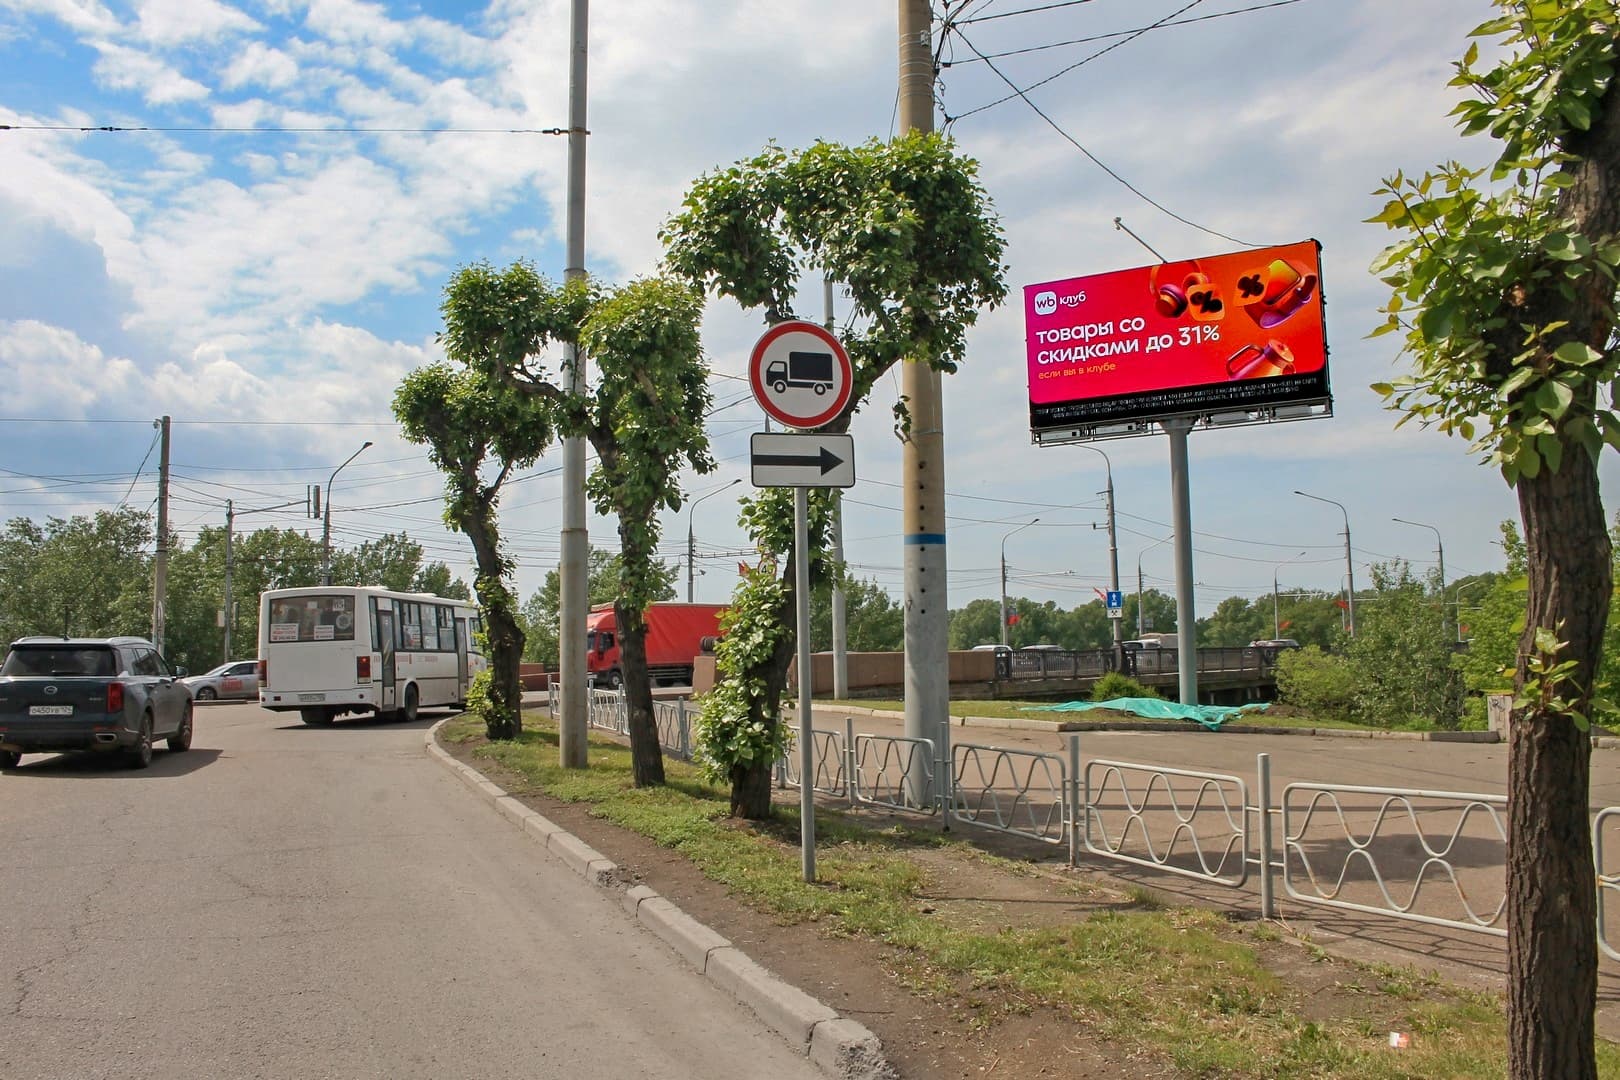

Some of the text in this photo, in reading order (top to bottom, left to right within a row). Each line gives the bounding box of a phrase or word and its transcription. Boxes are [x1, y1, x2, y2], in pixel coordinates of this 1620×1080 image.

[1036, 296, 1055, 309] wb
[1060, 290, 1086, 306] клуб
[1036, 317, 1145, 344] товары со
[1037, 325, 1220, 365] скидками до 31%
[1038, 362, 1116, 380] если вы в клубе
